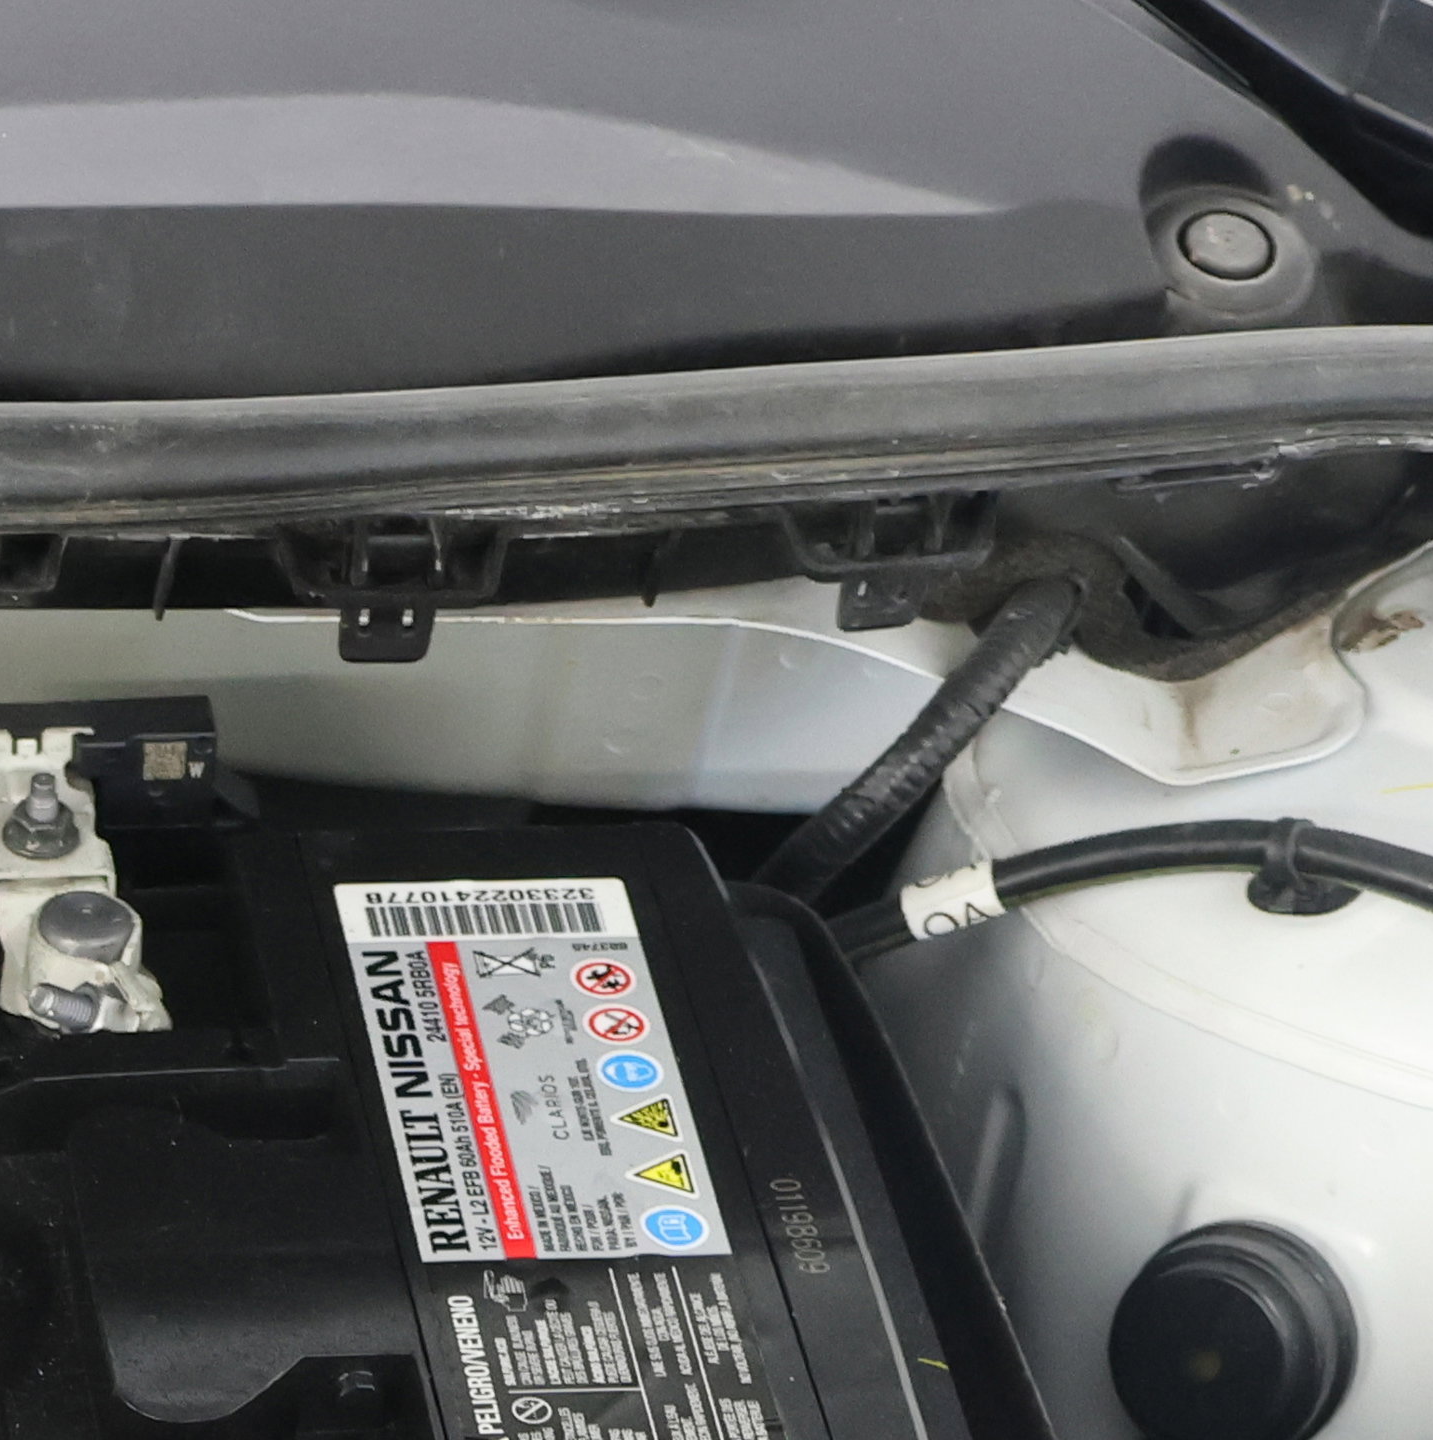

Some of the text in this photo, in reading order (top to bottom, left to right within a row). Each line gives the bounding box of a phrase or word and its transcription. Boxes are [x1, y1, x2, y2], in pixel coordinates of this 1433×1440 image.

[437, 1073, 464, 1098] (EN)
[437, 961, 525, 1239] Enhanced Flooded Battery Special technology
[361, 950, 471, 1253] RENAULT NISSAN
[444, 1101, 468, 1132] 510A
[537, 1074, 570, 1140] CLARIOS
[452, 1135, 477, 1167] 60Ah
[461, 1170, 484, 1196] EFB
[468, 1199, 489, 1215] L2
[474, 1227, 498, 1249] 12V
[446, 1295, 504, 1434] PELIGRO/VENENO
